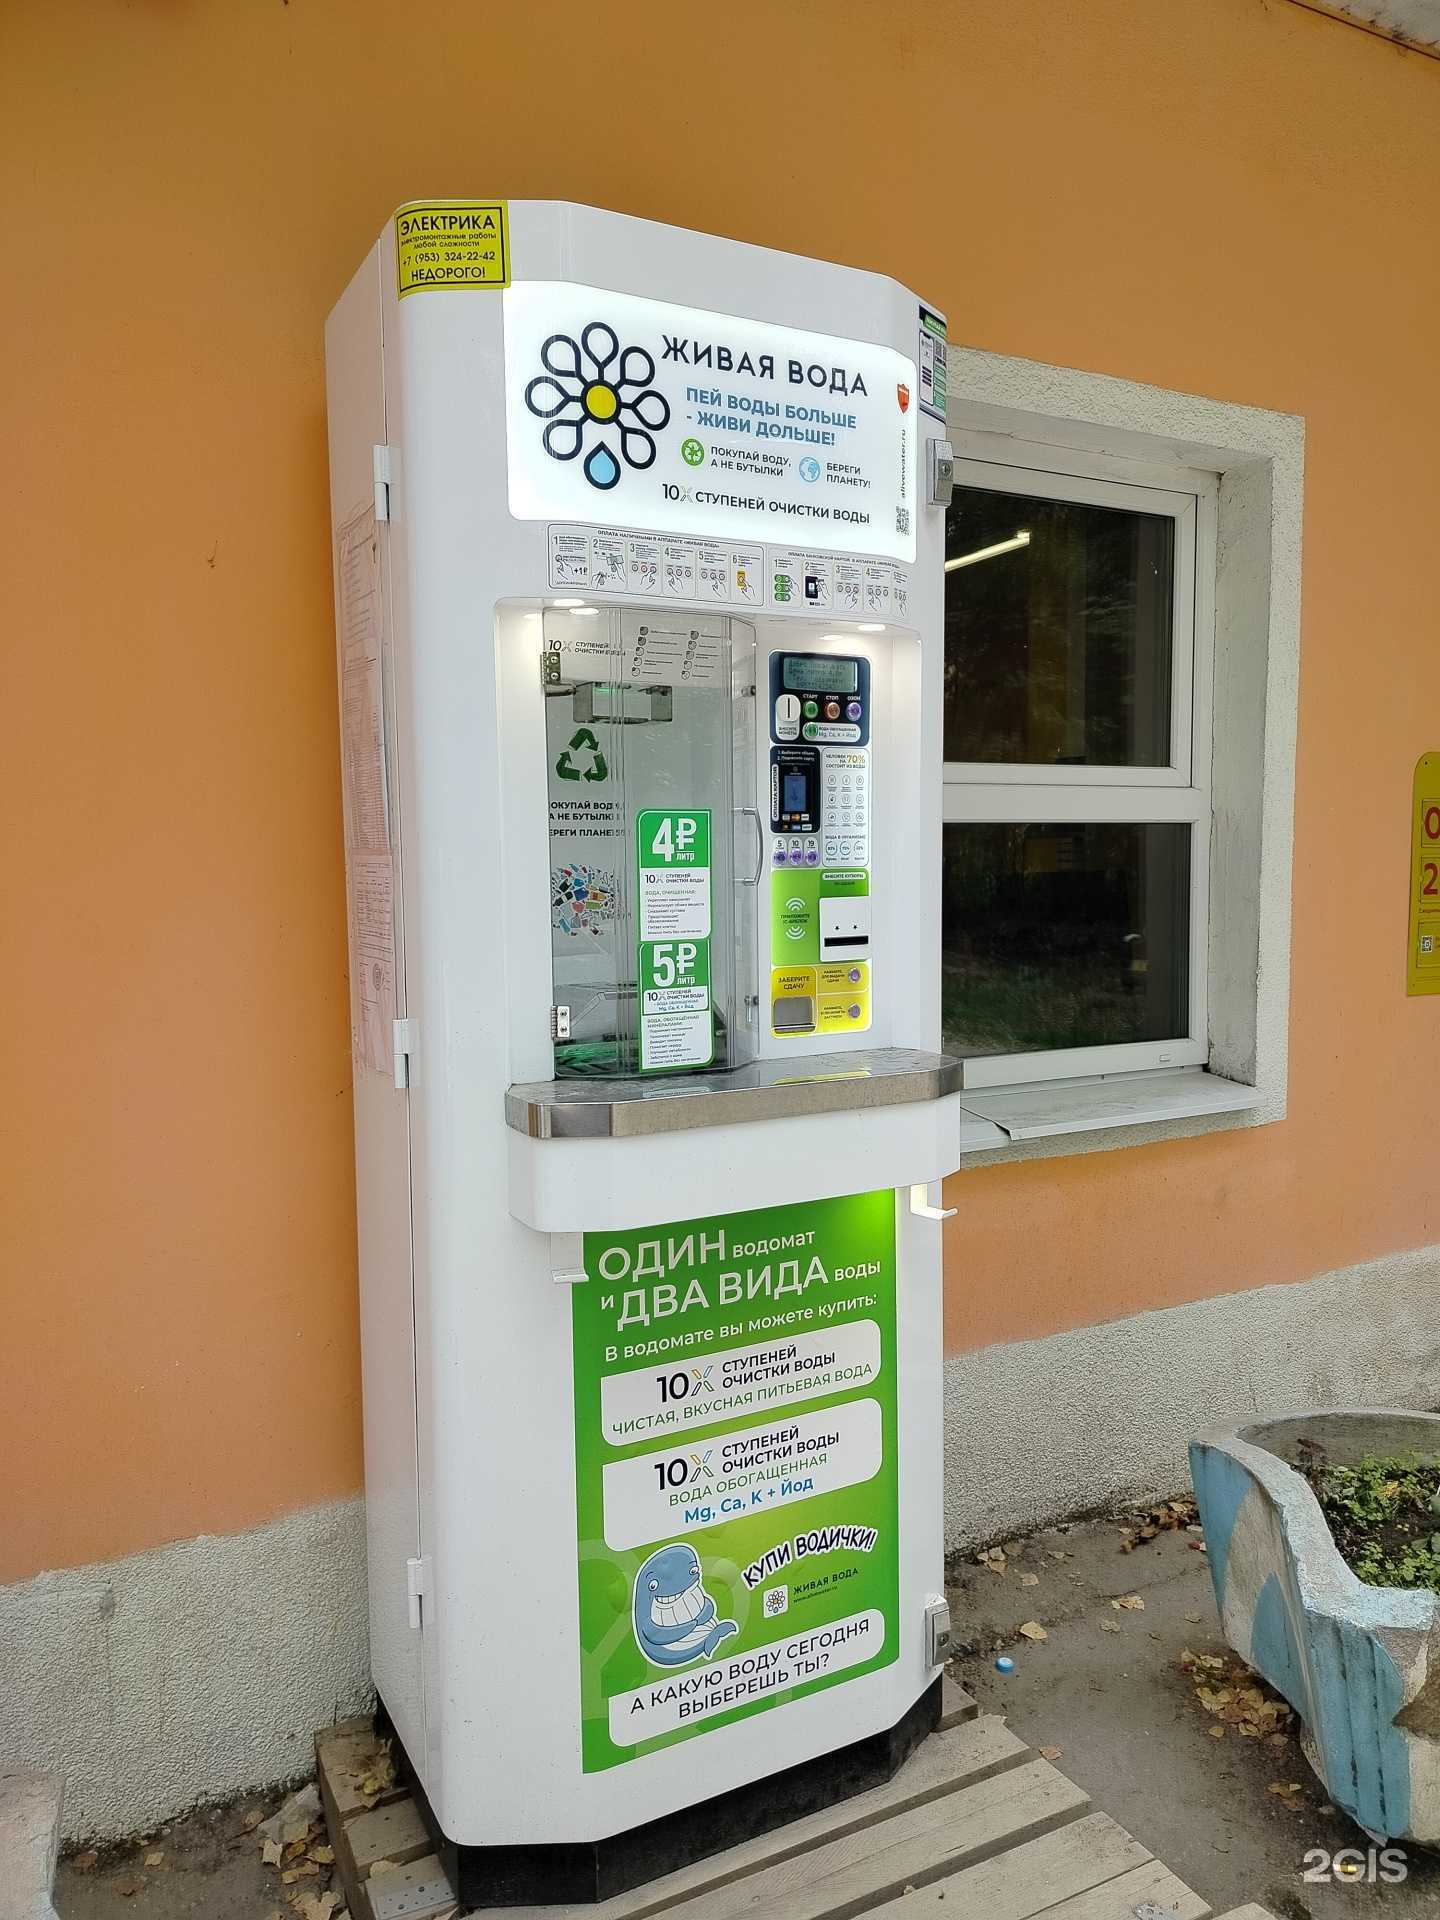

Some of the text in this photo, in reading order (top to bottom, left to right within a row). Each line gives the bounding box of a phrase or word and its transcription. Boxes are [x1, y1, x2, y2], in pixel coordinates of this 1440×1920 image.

[401, 215, 495, 236] ЭЛЕКТРИКА
[469, 232, 496, 240] работы
[403, 251, 496, 266] +7 (953) 324-22-42
[414, 240, 437, 249] любой
[411, 266, 486, 282] НЕДОРОГО!
[661, 334, 868, 397] ЖИВАЯ ВОДА
[686, 387, 857, 429] ПЕЙ ВОДЫ БОЛЬШЕ
[697, 410, 752, 433] ЖИВИ
[755, 421, 836, 447] ДОЛЬШЕ!
[711, 446, 792, 467] ПОКУПАЙ ВОДУ,
[711, 459, 784, 477] А НЕ БУТЫЛКИ
[826, 462, 861, 475] БЕРЕГИ
[826, 474, 871, 489] ПЛАНЕТУ!
[695, 491, 765, 511] СТУПЕНЕЙ
[769, 501, 829, 519] ОЧИСТКИ
[833, 508, 870, 524] ВОДЫ
[575, 641, 609, 650] СТУПЕНЕЙ
[551, 800, 591, 809] ОКУПАЙ
[598, 1230, 815, 1283] ОДИН водомат
[600, 1256, 881, 1332] и ДВА ВИДА воды
[605, 1295, 878, 1362] В водомате вы можете купить:
[722, 1345, 797, 1373] СТУПЕНЕЙ
[722, 1352, 836, 1389] ОЧИСТКИ ВОДЫ
[612, 1363, 873, 1435] ЧИСТАЯ, ВКУСНАЯ ПИТЬЕВАЯ ВОДА
[722, 1425, 800, 1458] СТУПЕНЕЙ
[722, 1432, 840, 1474] ОЧИСТКИ ВОДЫ
[668, 1453, 828, 1507] ВОДА ОБОГАЩЕННАЯ
[684, 1477, 814, 1523] Mg, Ca, K + Йод
[743, 1528, 876, 1588] КУПИ ВОДИЧКИ!
[793, 1576, 829, 1596] ЖИВАЯ
[832, 1567, 859, 1585] ВОДА
[630, 1619, 870, 1715] А КАКУЮ ВОДУ СЕГОДНЯ
[679, 1653, 830, 1719] ВЫБЕРЕШЬ ТЫ?
